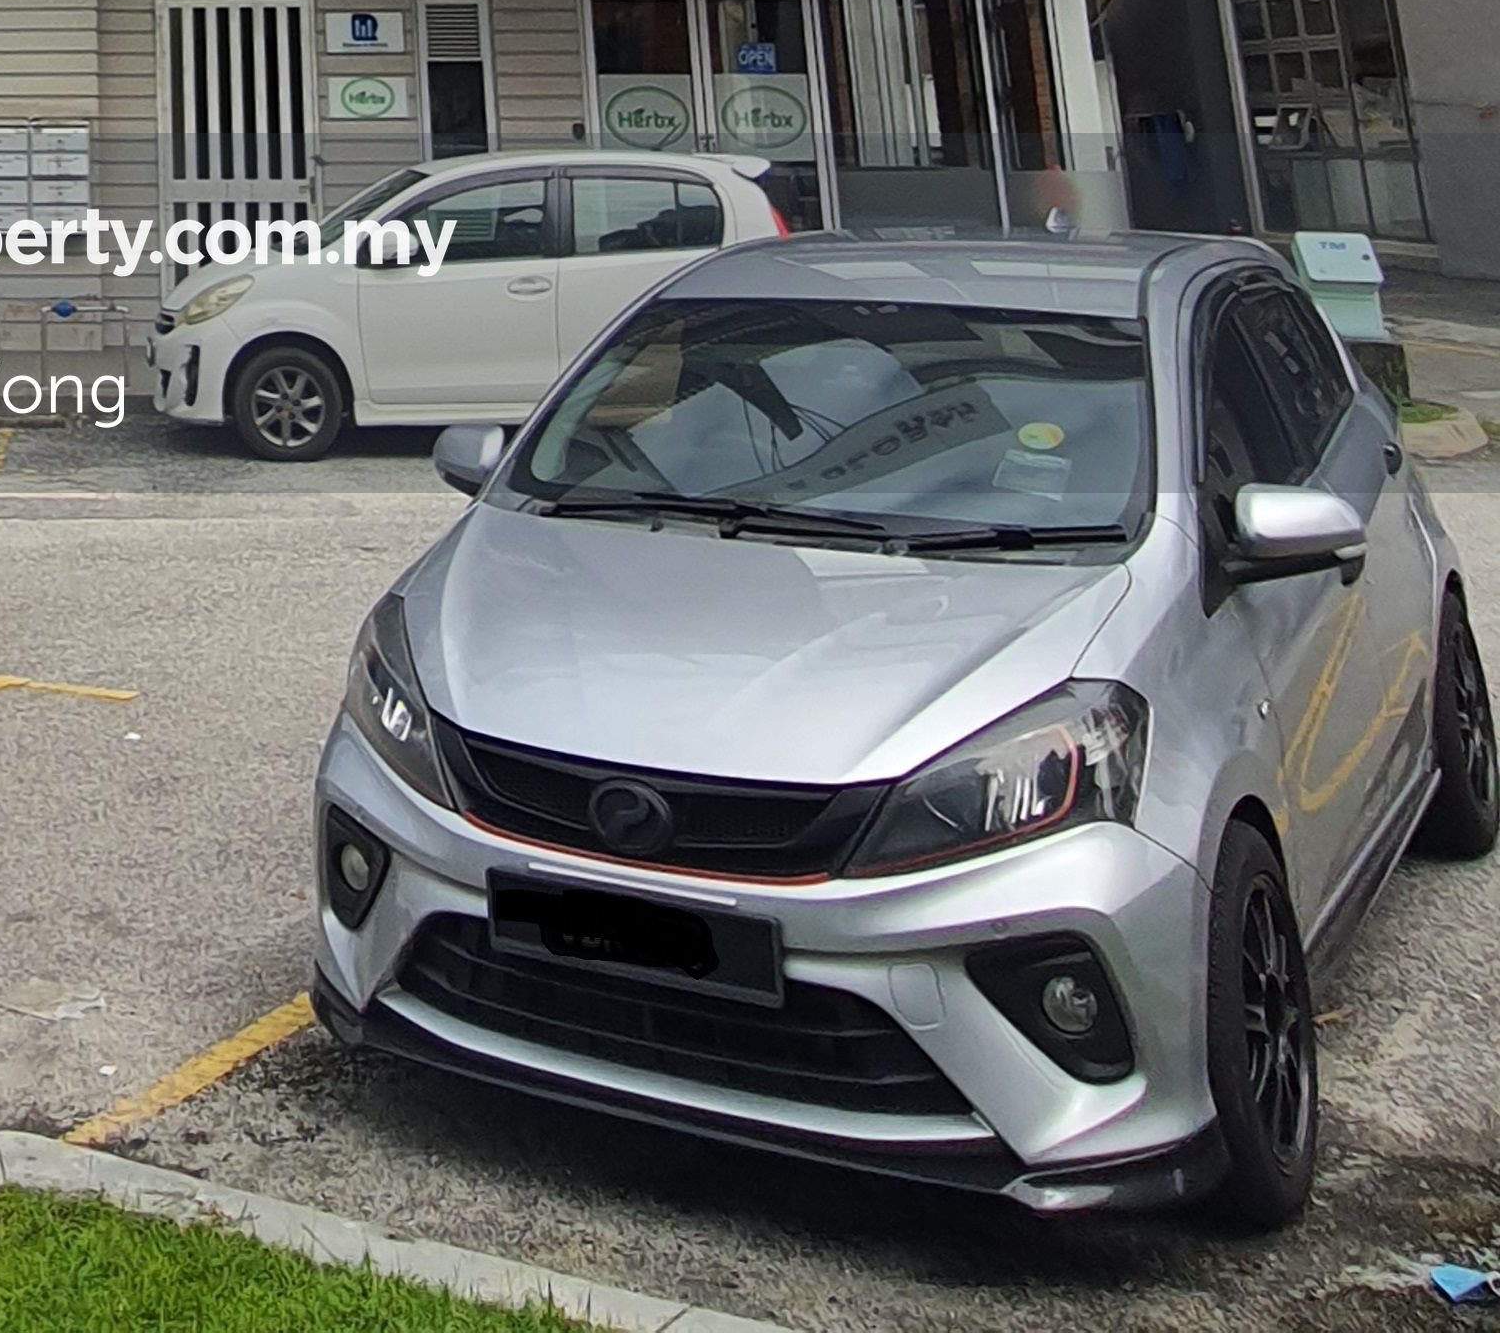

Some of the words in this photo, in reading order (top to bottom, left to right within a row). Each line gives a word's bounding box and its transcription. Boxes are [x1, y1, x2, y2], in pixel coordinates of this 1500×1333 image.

[738, 49, 775, 67] OPEN
[617, 108, 676, 129] Herbx
[735, 107, 794, 129] Herbx
